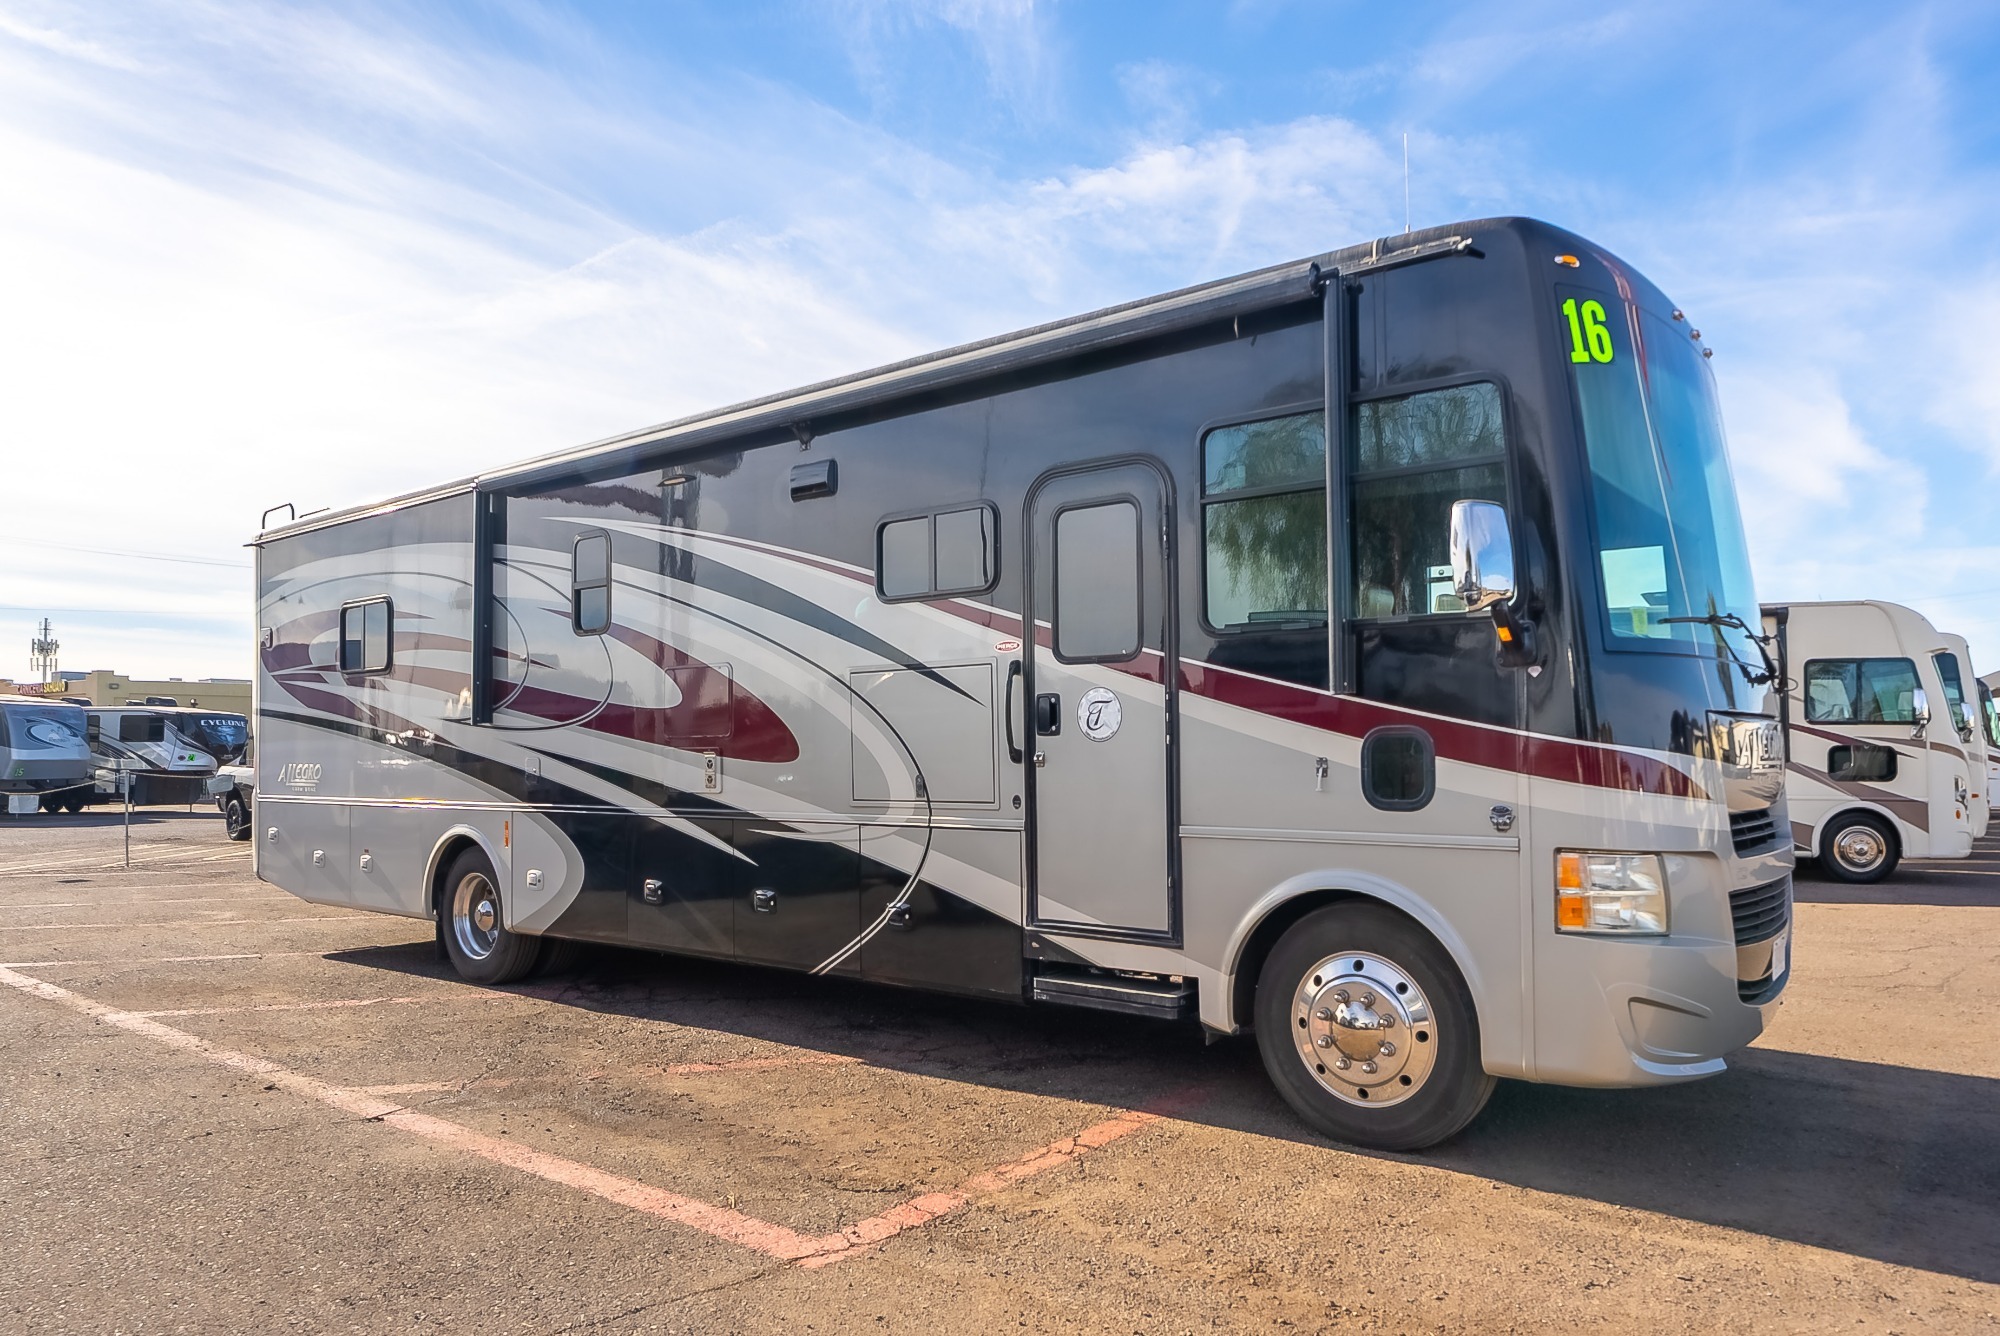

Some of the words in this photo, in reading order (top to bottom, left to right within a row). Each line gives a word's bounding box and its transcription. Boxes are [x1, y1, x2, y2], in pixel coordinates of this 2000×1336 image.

[1562, 298, 1614, 364] 16
[200, 719, 247, 728] CYCLONE
[277, 763, 322, 786] ALLEGRO
